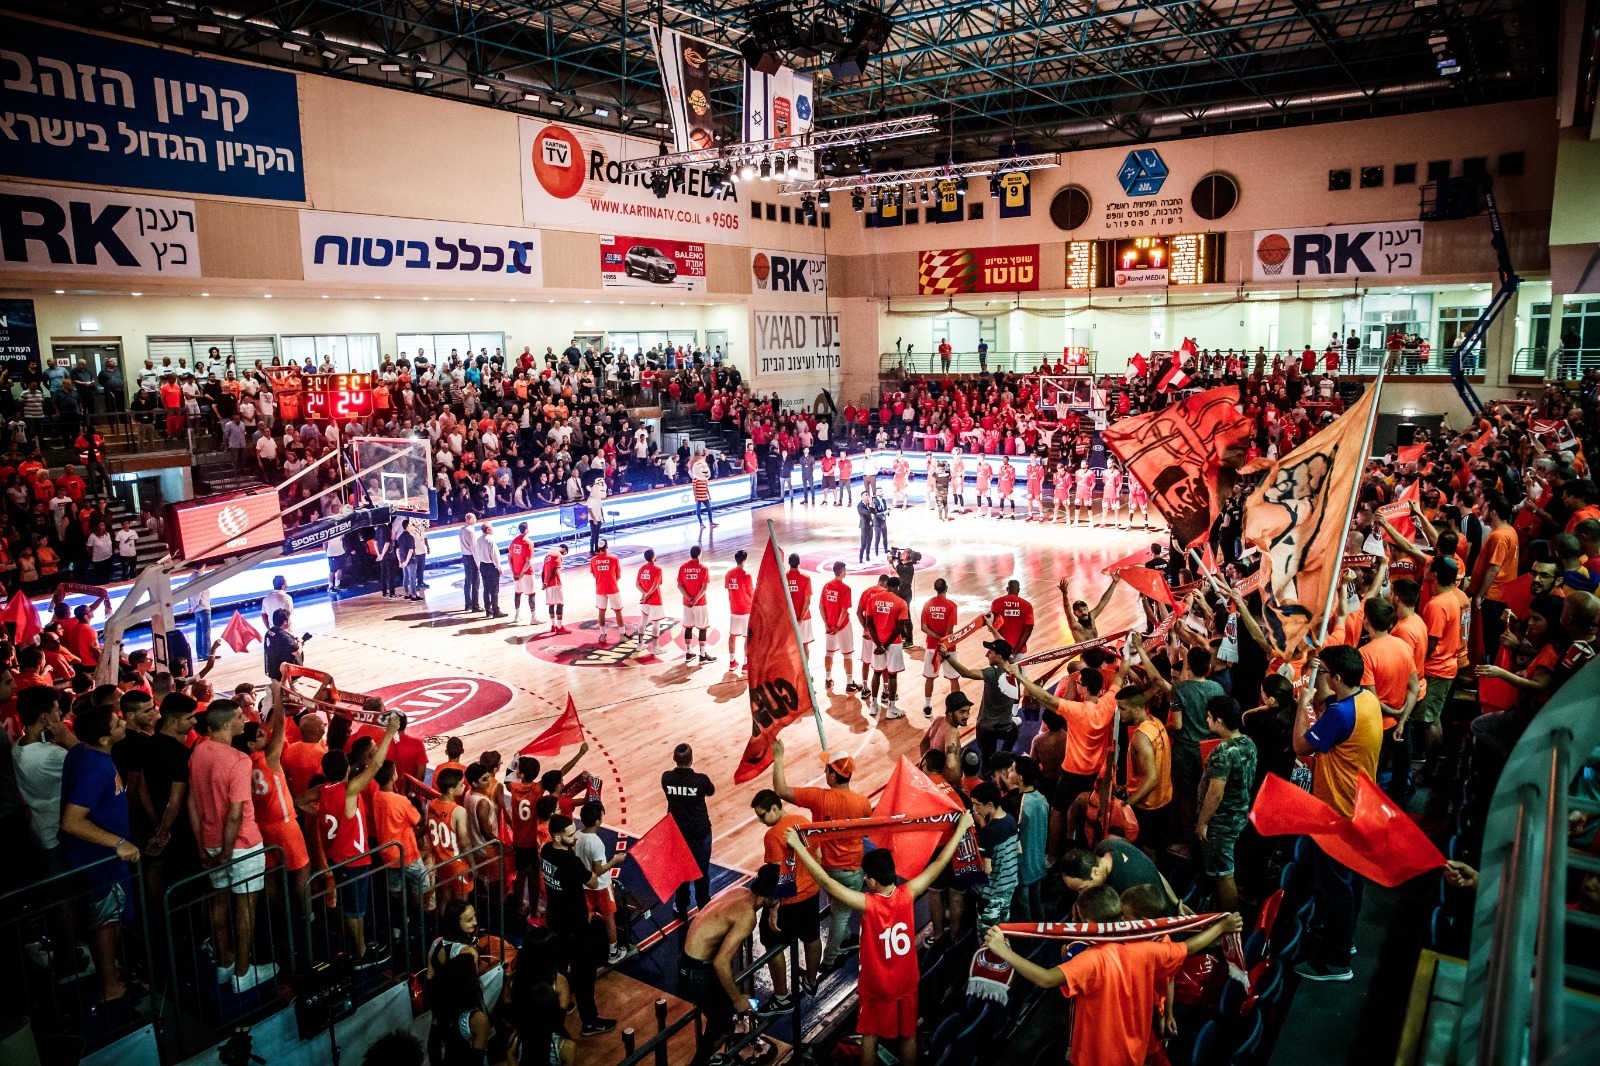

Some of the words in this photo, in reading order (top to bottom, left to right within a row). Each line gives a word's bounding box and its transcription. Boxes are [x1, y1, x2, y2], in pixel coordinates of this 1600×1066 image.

[1, 50, 136, 109] הזהב
[154, 77, 249, 132] קניון
[118, 121, 206, 163] הגדול
[545, 141, 567, 150] KARTINA
[216, 140, 295, 175] הקניון
[546, 147, 568, 163] TV
[944, 193, 955, 202] 18
[1010, 186, 1018, 197] 9
[1161, 199, 1182, 207] החברה
[136, 207, 195, 236] רענן
[590, 199, 701, 224] WWW.KARTINATV.CO.IL
[712, 213, 739, 230] 9505
[0, 194, 142, 267] RK
[1378, 229, 1421, 250] רענן
[150, 241, 187, 271] כץ
[314, 234, 431, 269] ביטוח
[435, 236, 505, 272] כלל
[674, 251, 704, 259] BALENO
[985, 257, 1008, 265] בסיוע
[1010, 256, 1032, 264] שופץ
[1292, 232, 1376, 275] RK
[1385, 253, 1412, 273] כץ
[771, 256, 809, 292] RK
[812, 278, 824, 294] כץ
[984, 266, 1033, 284] טוטו
[757, 315, 806, 350] YA'AD
[762, 357, 784, 372] הבית
[787, 355, 815, 371] ועיצוב
[667, 786, 698, 796] צוות
[519, 799, 531, 821] 6
[325, 814, 338, 840] 2
[428, 819, 450, 848] 30
[879, 922, 911, 959] 16
